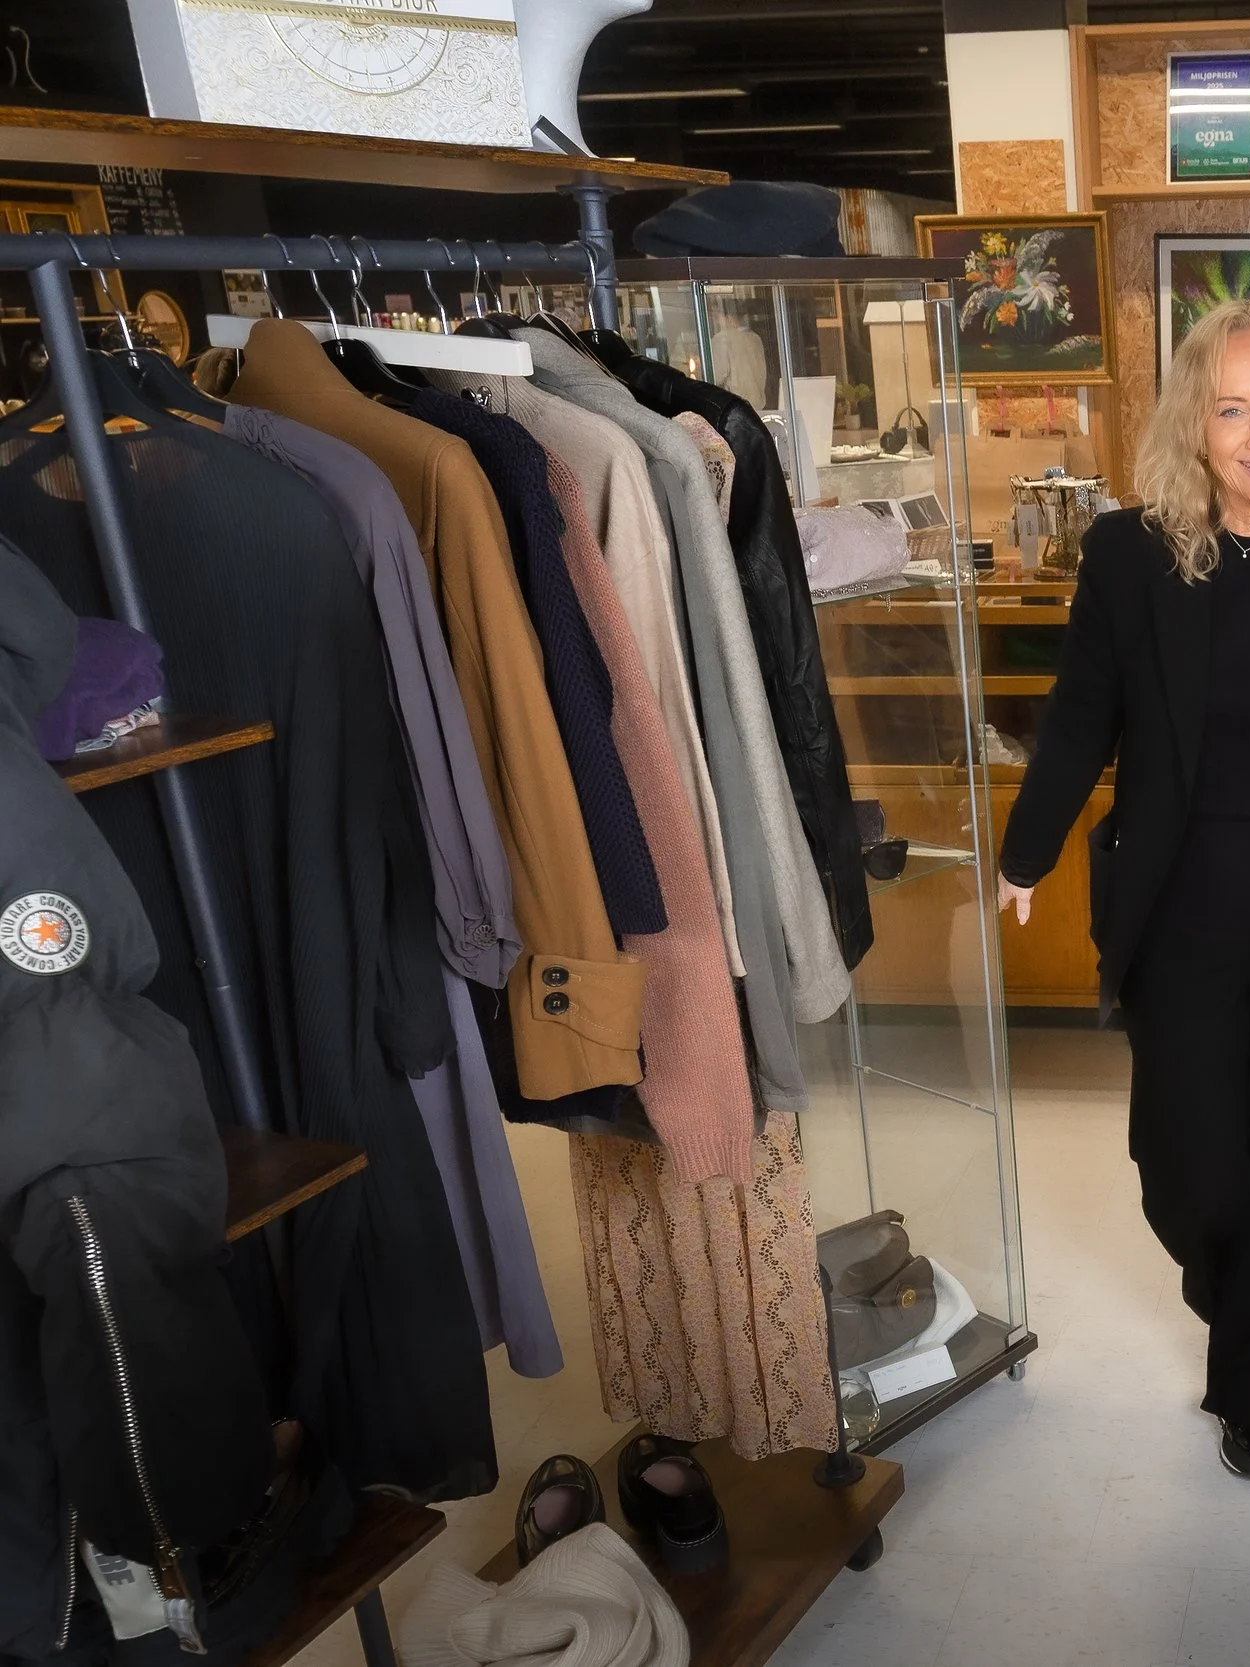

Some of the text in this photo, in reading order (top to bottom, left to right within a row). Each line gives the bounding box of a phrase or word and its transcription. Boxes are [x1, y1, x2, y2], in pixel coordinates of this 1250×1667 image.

[1190, 71, 1238, 81] MILJØPRISEN
[1195, 129, 1234, 148] egna
[0, 898, 55, 970] COME AS YOU ARE
[40, 896, 87, 966] COME AS YOU ARE
